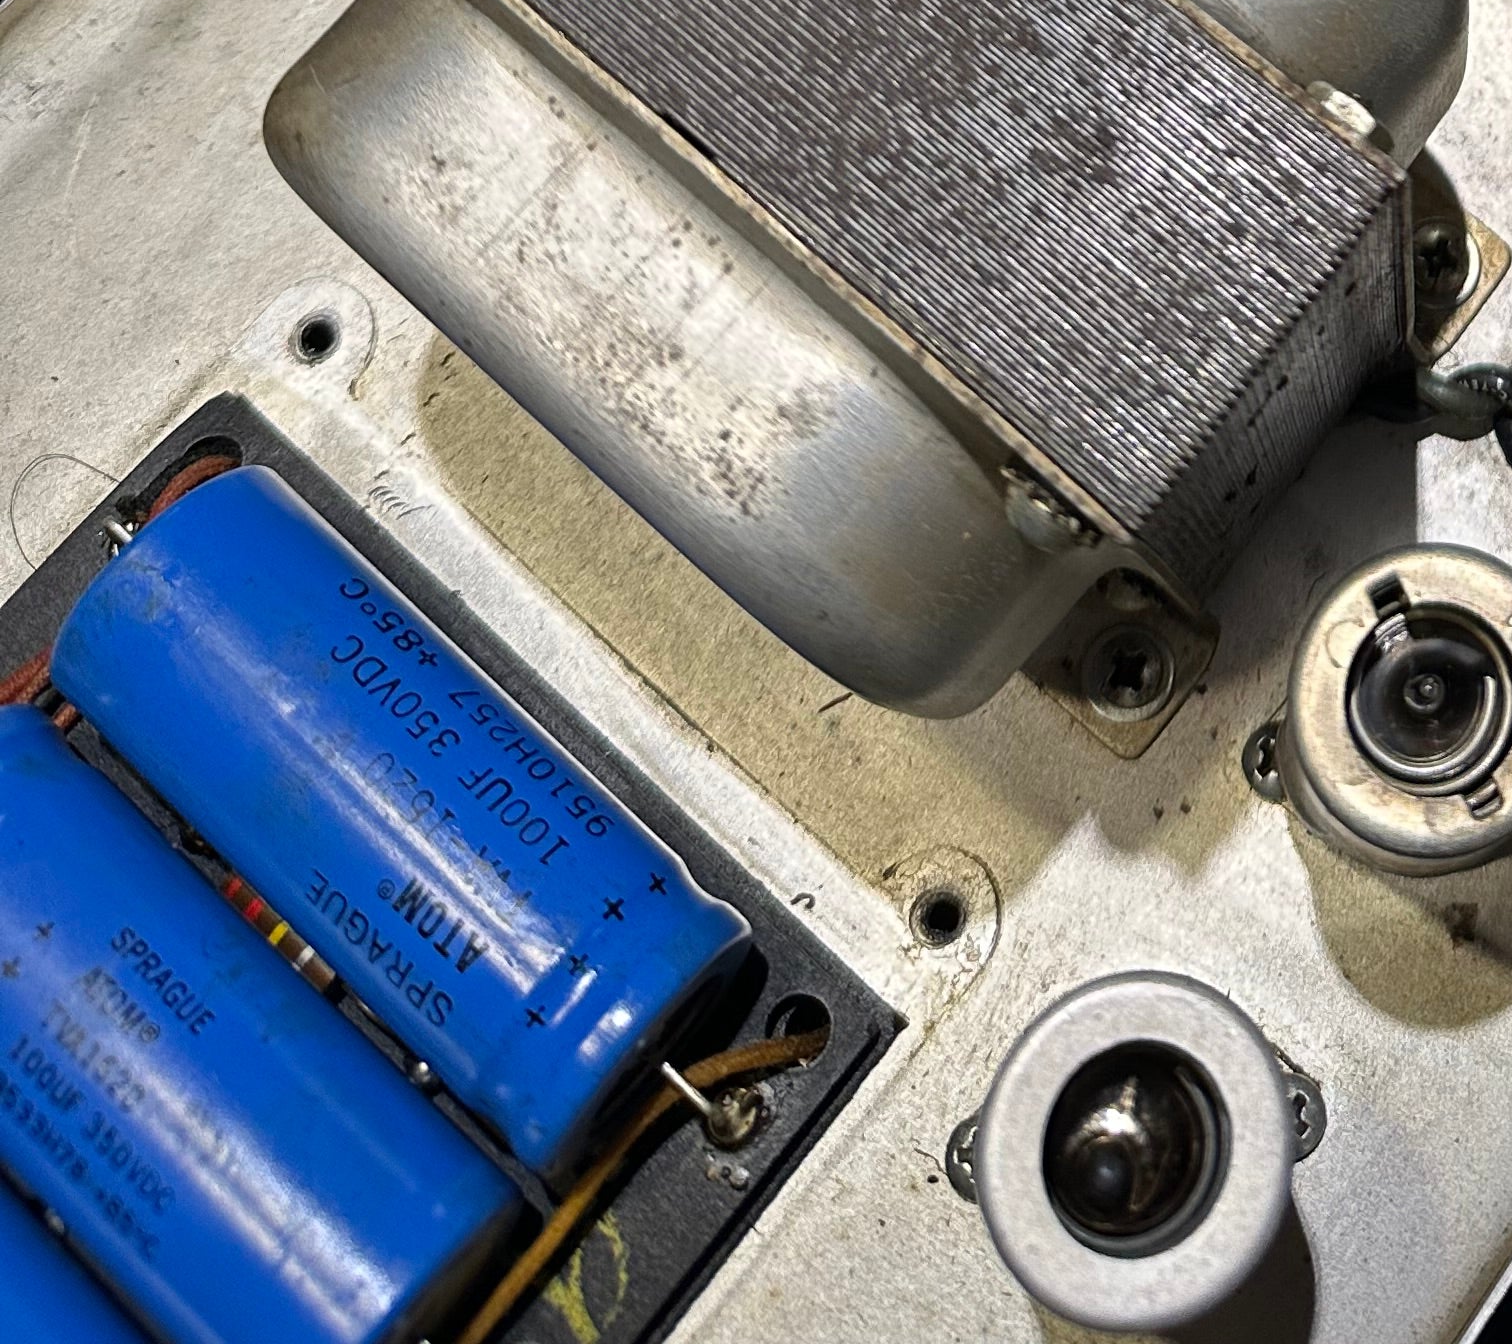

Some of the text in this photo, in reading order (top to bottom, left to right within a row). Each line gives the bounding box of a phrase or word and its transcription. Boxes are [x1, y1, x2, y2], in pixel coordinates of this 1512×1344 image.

[328, 632, 572, 867] 100UF 350VDC
[447, 688, 618, 840] 9510H257
[110, 925, 217, 1036] SPRAGUE
[304, 867, 455, 1028] SPRAGUE
